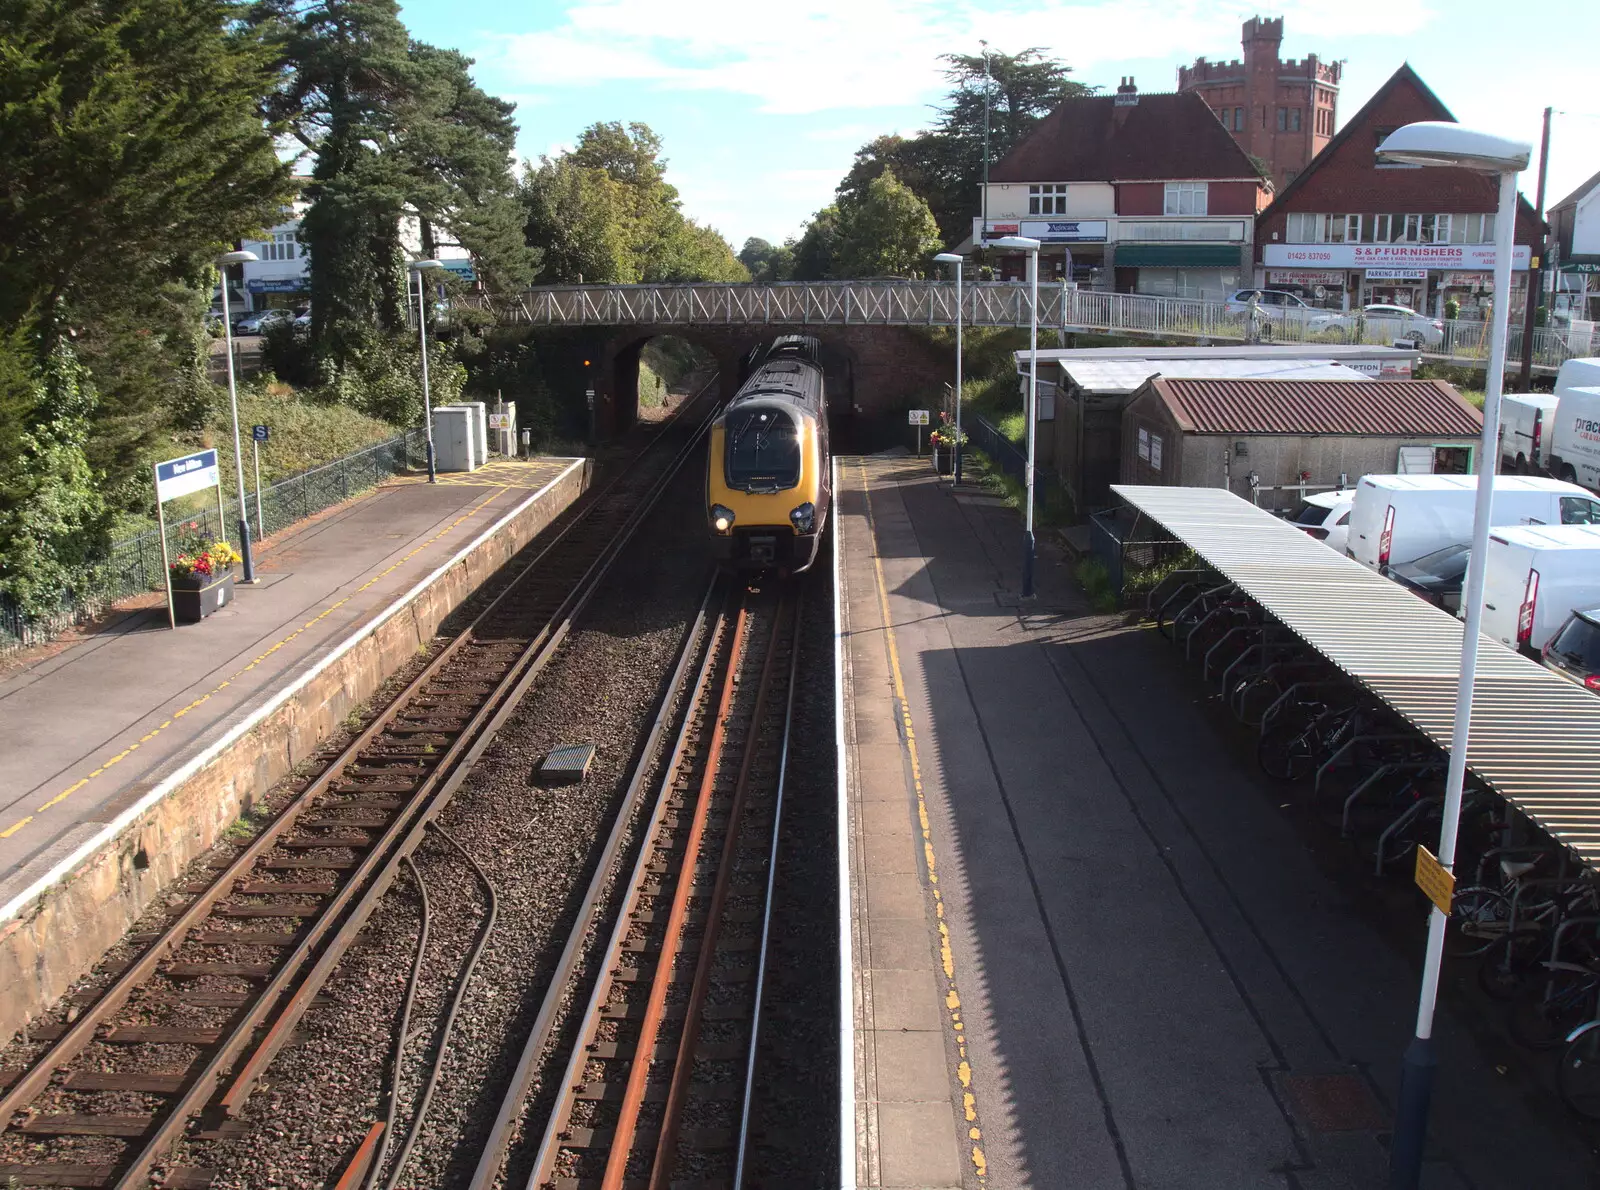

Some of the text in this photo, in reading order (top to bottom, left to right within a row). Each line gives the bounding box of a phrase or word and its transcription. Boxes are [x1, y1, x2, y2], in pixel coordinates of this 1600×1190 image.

[1287, 252, 1306, 260] 01425
[1355, 247, 1463, 257] S & P FURNISHERS
[1574, 417, 1600, 433] prac
[256, 426, 266, 438] S
